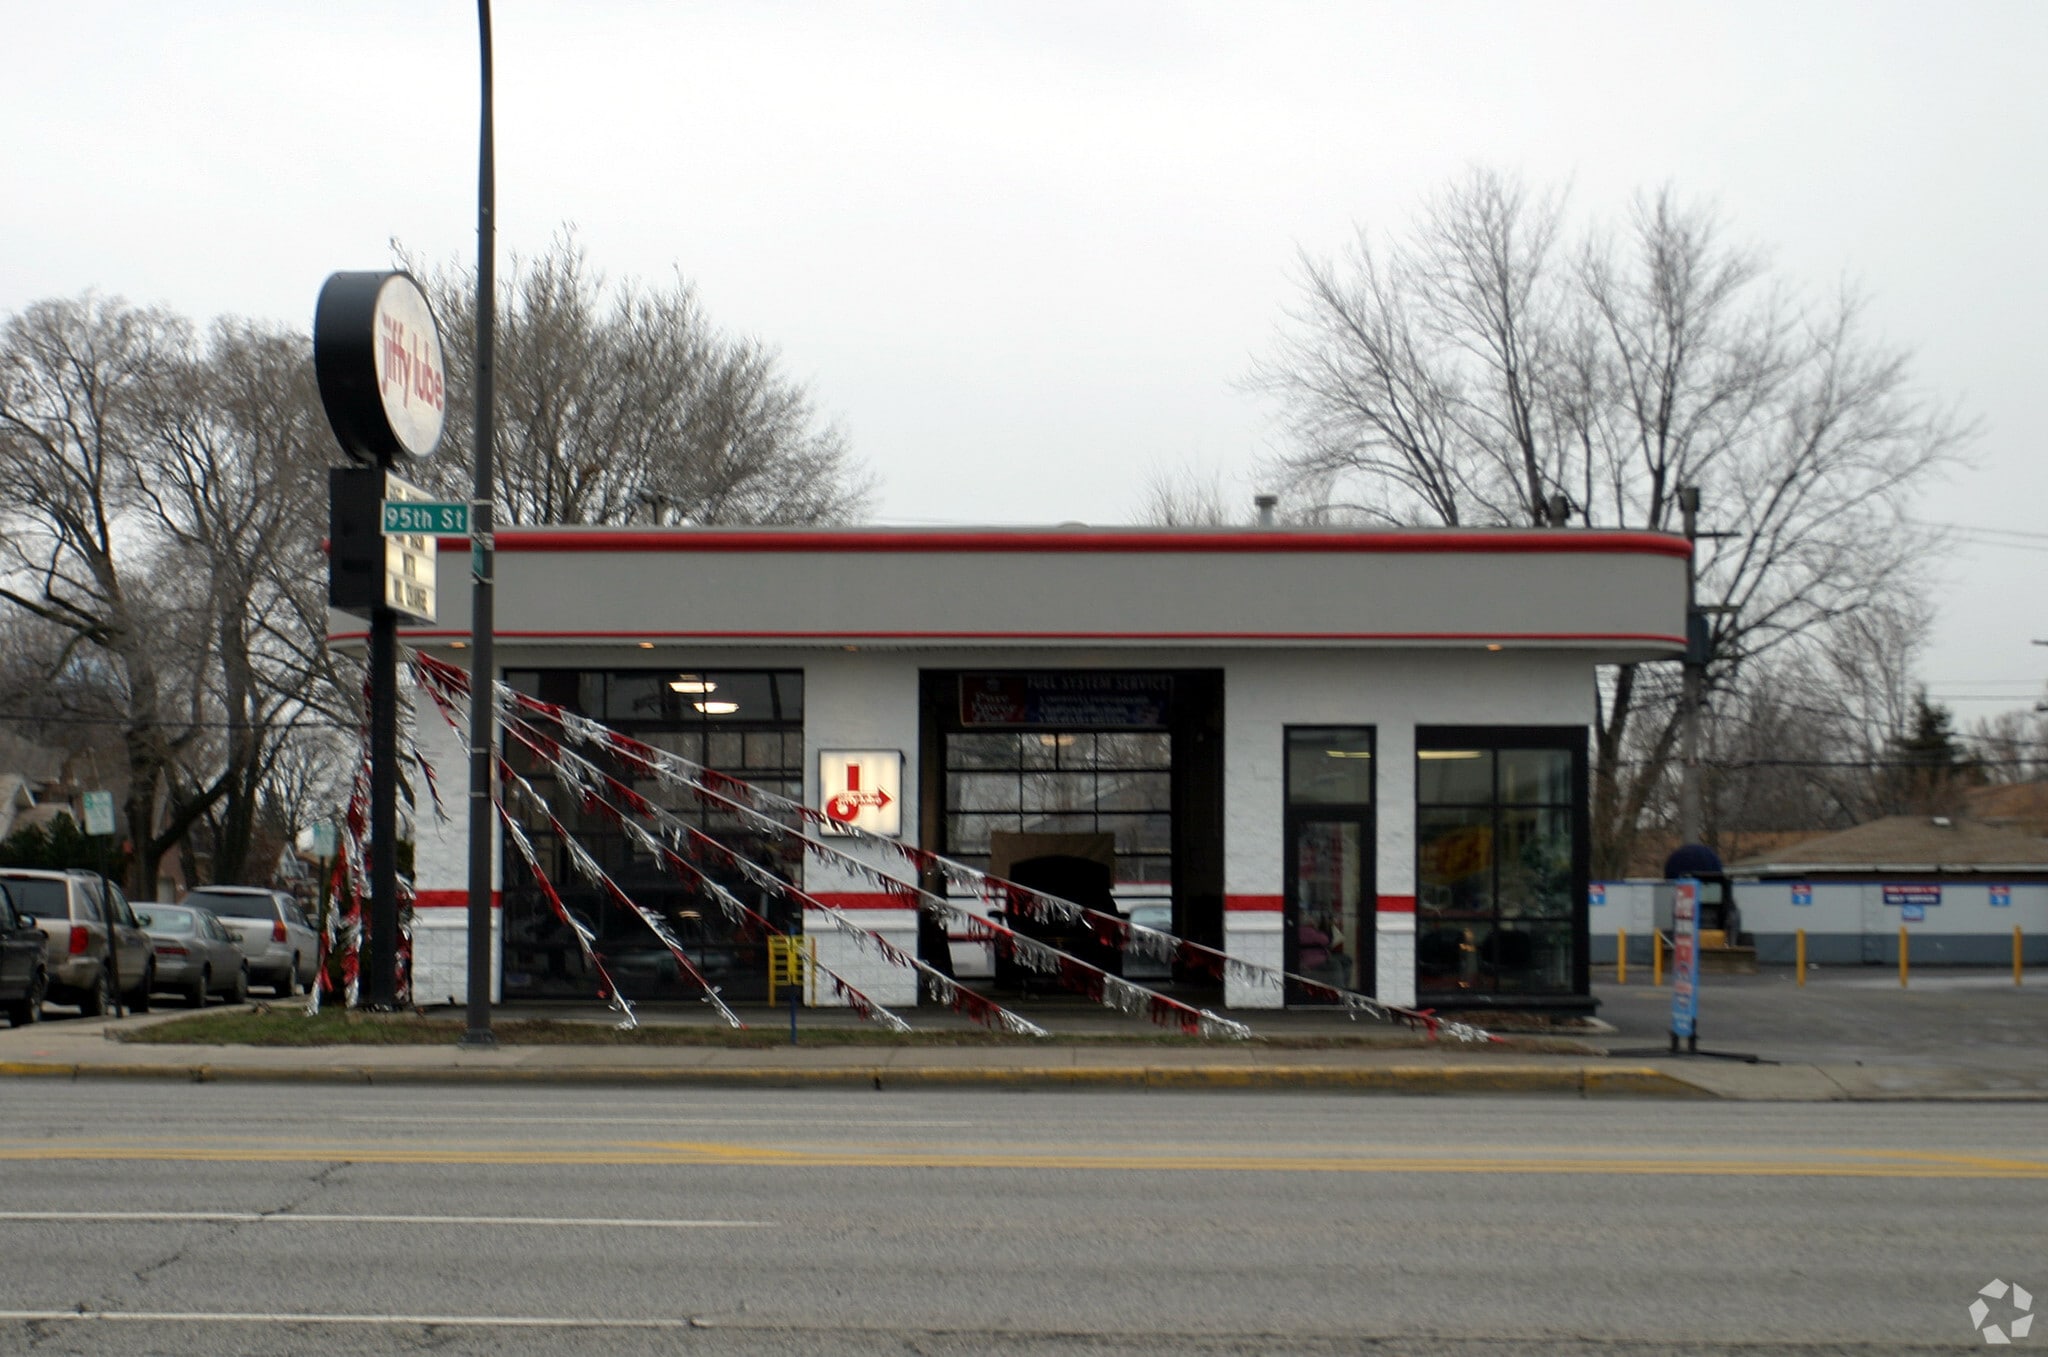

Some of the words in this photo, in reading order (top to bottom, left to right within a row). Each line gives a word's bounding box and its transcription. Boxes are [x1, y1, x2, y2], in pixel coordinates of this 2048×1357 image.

[382, 311, 411, 409] jiffy
[412, 332, 443, 411] lube
[386, 506, 432, 529] 95th
[441, 507, 464, 530] St
[1027, 674, 1056, 689] FUEL
[1061, 674, 1111, 689] SYSTEM
[1116, 674, 1168, 690] SERVICE
